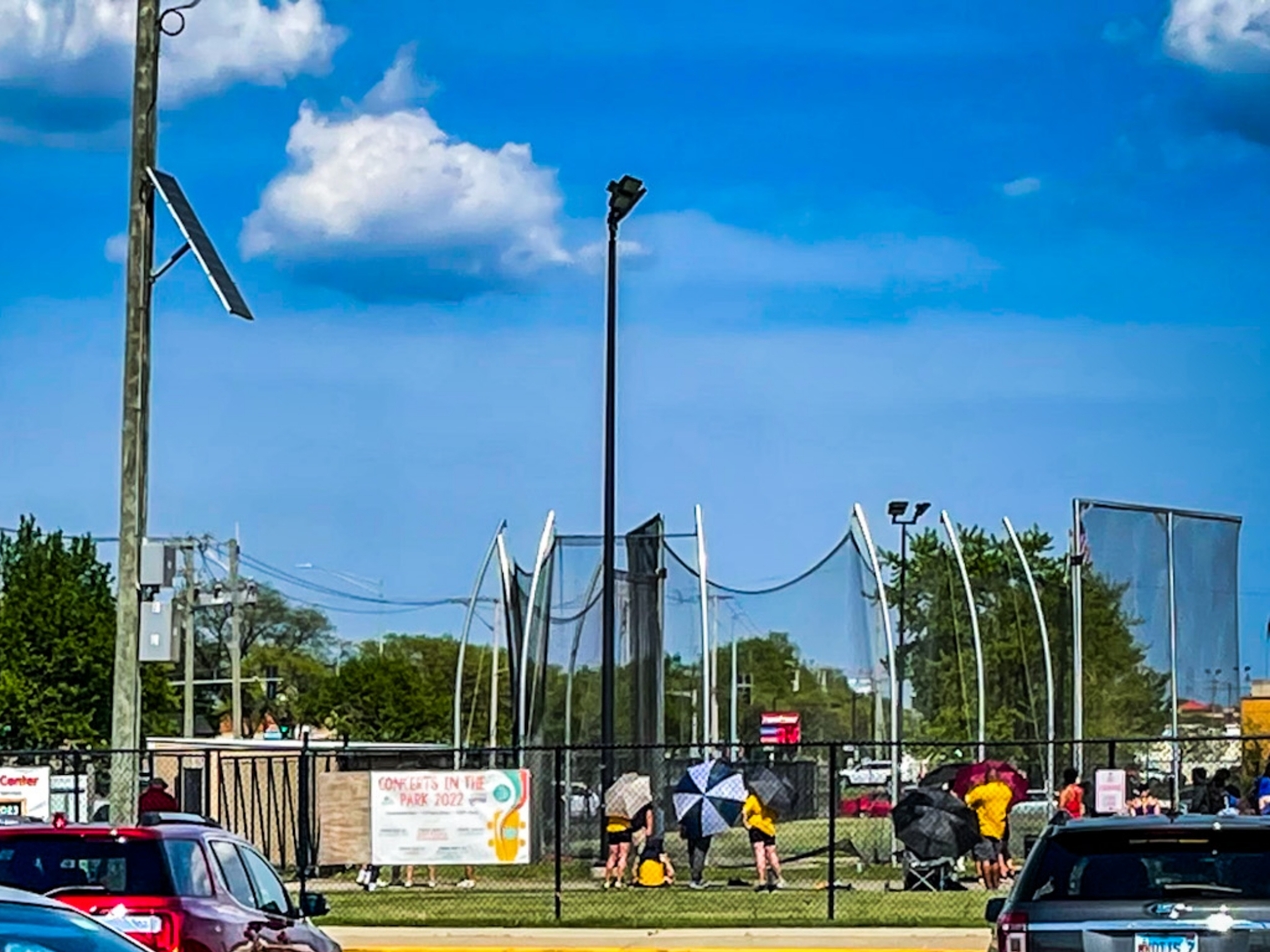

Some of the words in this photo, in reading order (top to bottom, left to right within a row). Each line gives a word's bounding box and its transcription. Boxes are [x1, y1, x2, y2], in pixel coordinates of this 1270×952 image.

[0, 775, 39, 786] Center
[378, 776, 439, 791] CONCERTS
[444, 776, 460, 790] IN
[464, 775, 486, 790] THE
[400, 793, 429, 807] PARK
[434, 793, 465, 807] 2022
